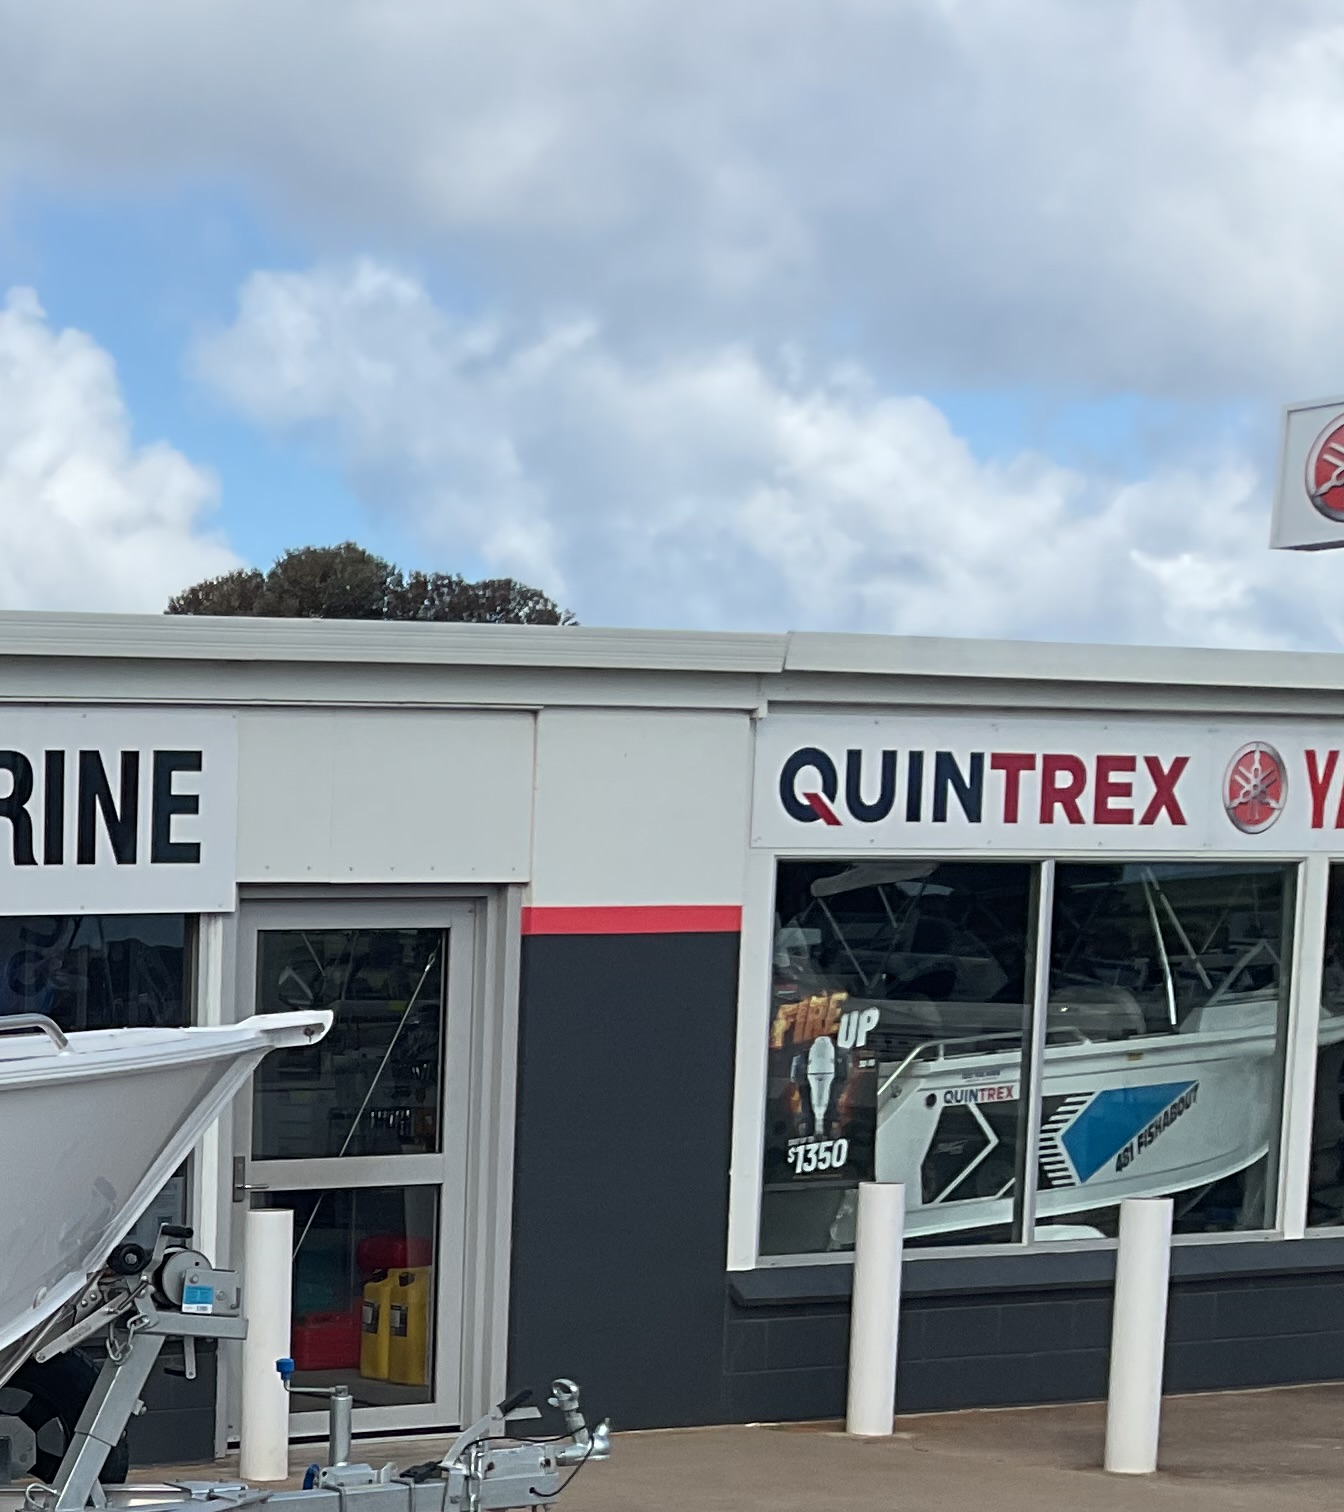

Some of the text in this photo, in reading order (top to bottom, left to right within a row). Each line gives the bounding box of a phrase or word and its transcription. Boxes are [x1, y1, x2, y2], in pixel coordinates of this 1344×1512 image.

[779, 746, 1192, 827] QUINTREX
[1304, 749, 1344, 829] Y
[770, 992, 880, 1049] FIRE UP
[943, 1084, 1015, 1104] QUINTREX
[1137, 1082, 1200, 1155] FISHABOUT
[786, 1138, 849, 1174] $1350
